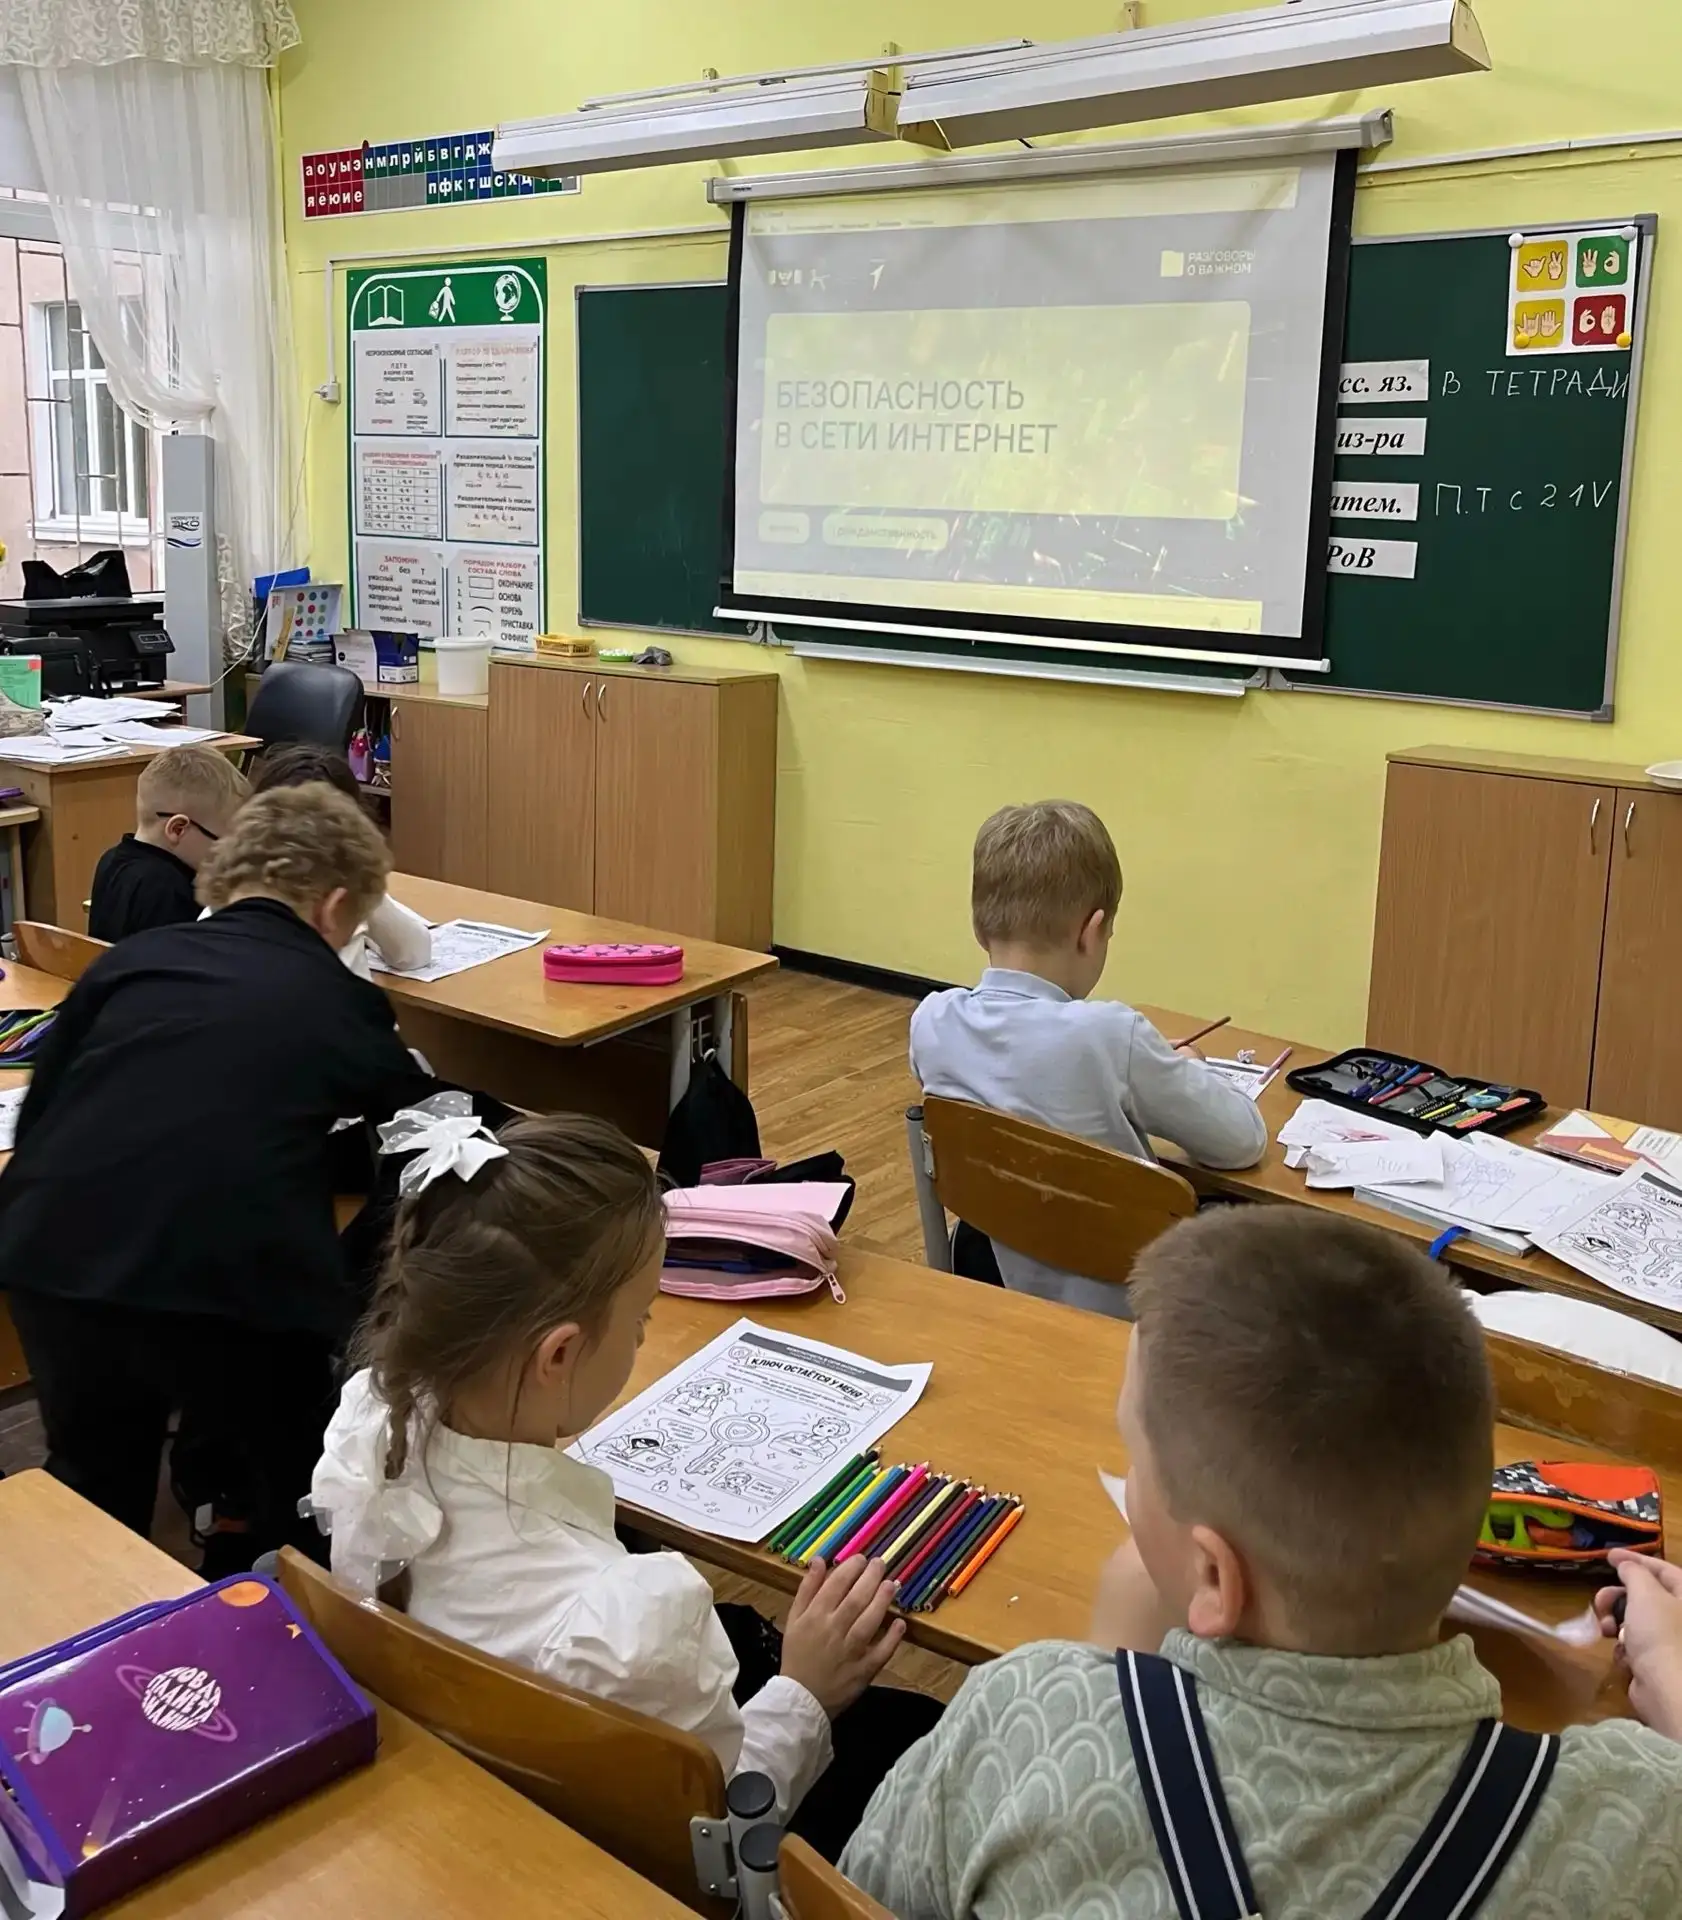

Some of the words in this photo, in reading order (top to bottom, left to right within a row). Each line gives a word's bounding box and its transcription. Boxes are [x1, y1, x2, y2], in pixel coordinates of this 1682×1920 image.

[776, 380, 1025, 411] БЕЗОПАСНОСТЬ
[1339, 377, 1370, 394] сс.
[1378, 375, 1412, 392] яз.
[1442, 370, 1461, 396] В
[1486, 367, 1629, 399] ТЕТРАДИ
[775, 421, 791, 448] В
[800, 421, 877, 450] СЕТИ
[888, 422, 1058, 454] ИНТЕРНЕТ
[1337, 432, 1406, 455] из-ра
[1329, 495, 1402, 514] атем.
[750, 1358, 783, 1370] КЛЮЧ
[836, 1382, 863, 1398] МЕНЯ
